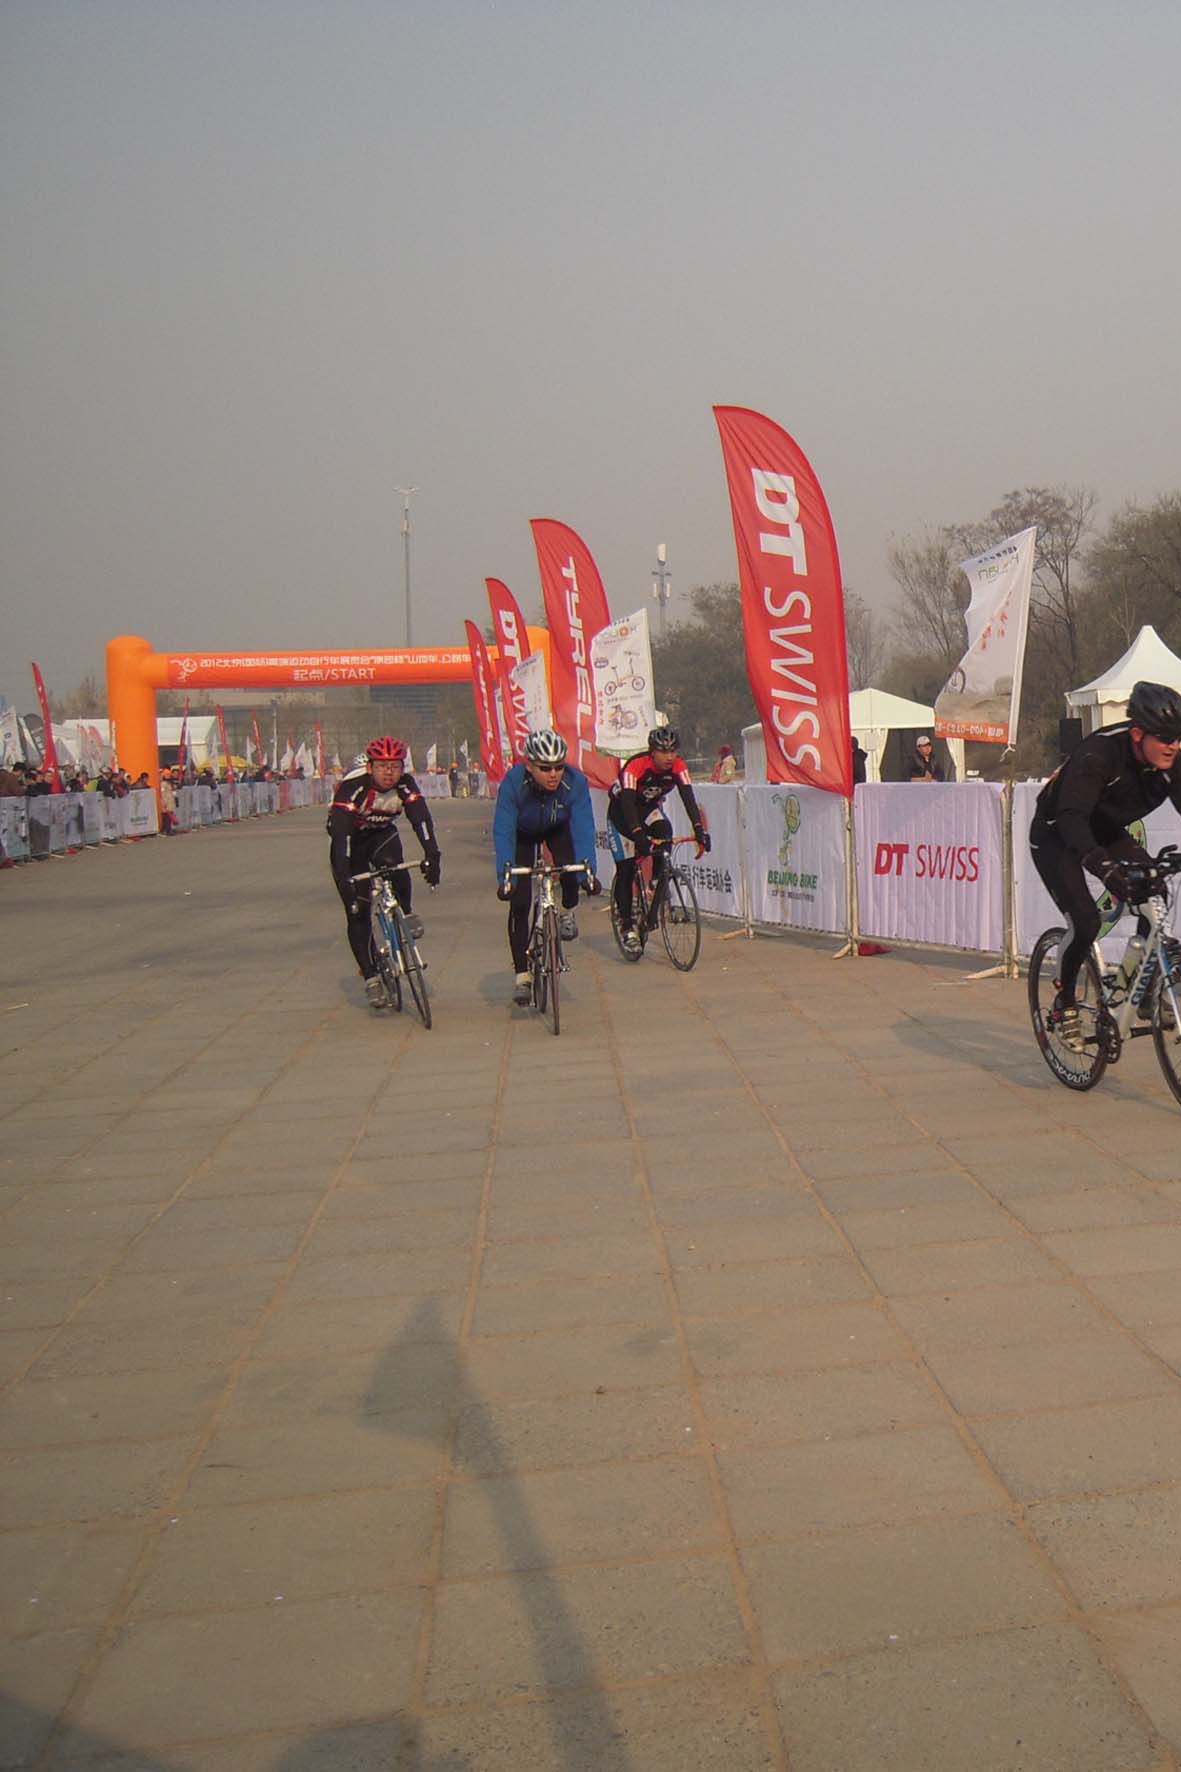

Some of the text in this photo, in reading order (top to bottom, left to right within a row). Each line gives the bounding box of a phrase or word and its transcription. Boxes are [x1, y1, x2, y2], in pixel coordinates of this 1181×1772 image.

[500, 609, 522, 666] DT
[752, 467, 822, 772] DT SWISS
[561, 556, 593, 771] TYRELL
[799, 872, 818, 889] BIKE
[874, 842, 980, 882] DT SWISS
